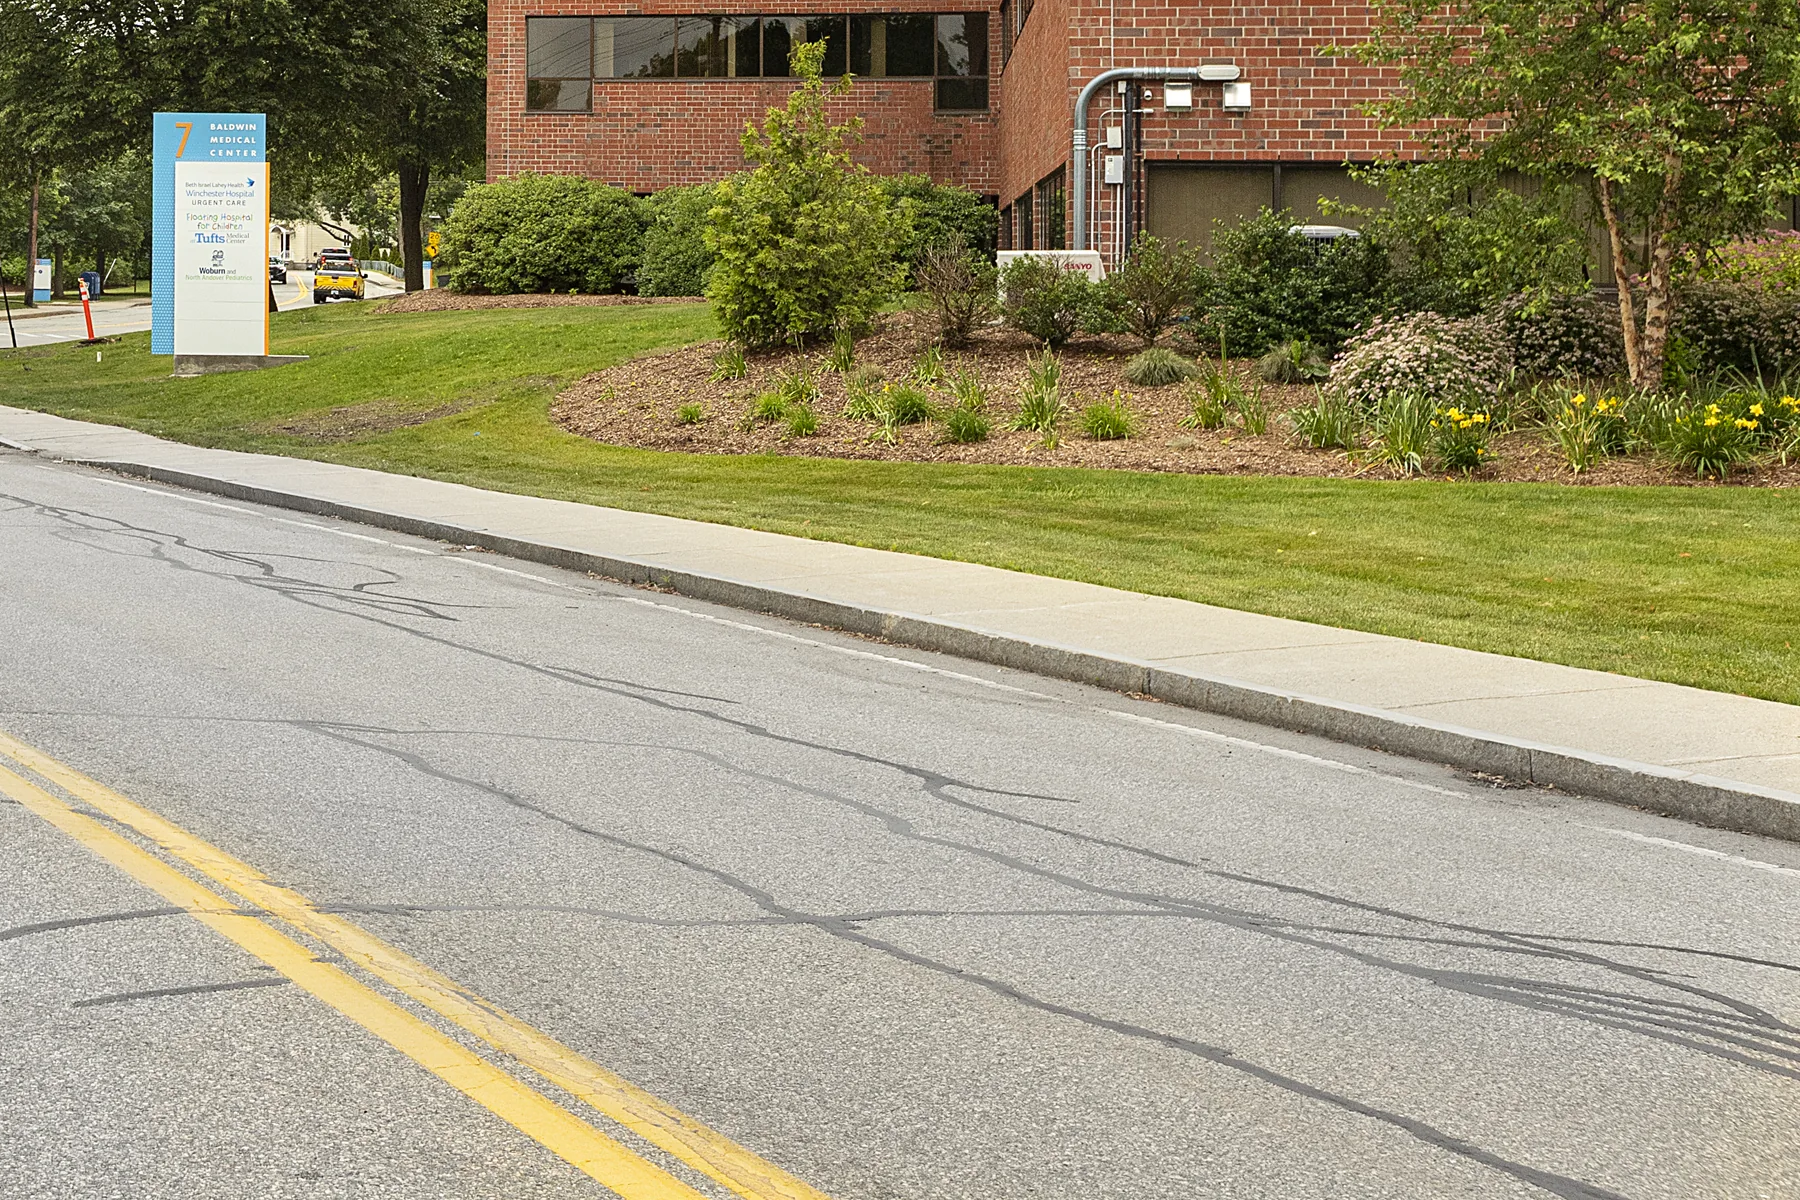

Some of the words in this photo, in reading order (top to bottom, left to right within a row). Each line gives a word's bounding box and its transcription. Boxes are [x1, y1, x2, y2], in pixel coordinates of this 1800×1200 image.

[210, 123, 257, 131] BALDWIN
[175, 122, 193, 158] 7
[210, 136, 257, 144] MEDICAL
[210, 149, 257, 157] CENTER
[185, 189, 224, 197] Winchester
[226, 190, 255, 199] Hospital
[186, 213, 219, 222] Floating
[220, 213, 253, 223] Hospital
[197, 222, 210, 230] for
[211, 222, 243, 230] Children
[194, 232, 226, 244] Tufts
[199, 267, 226, 275] Woburn
